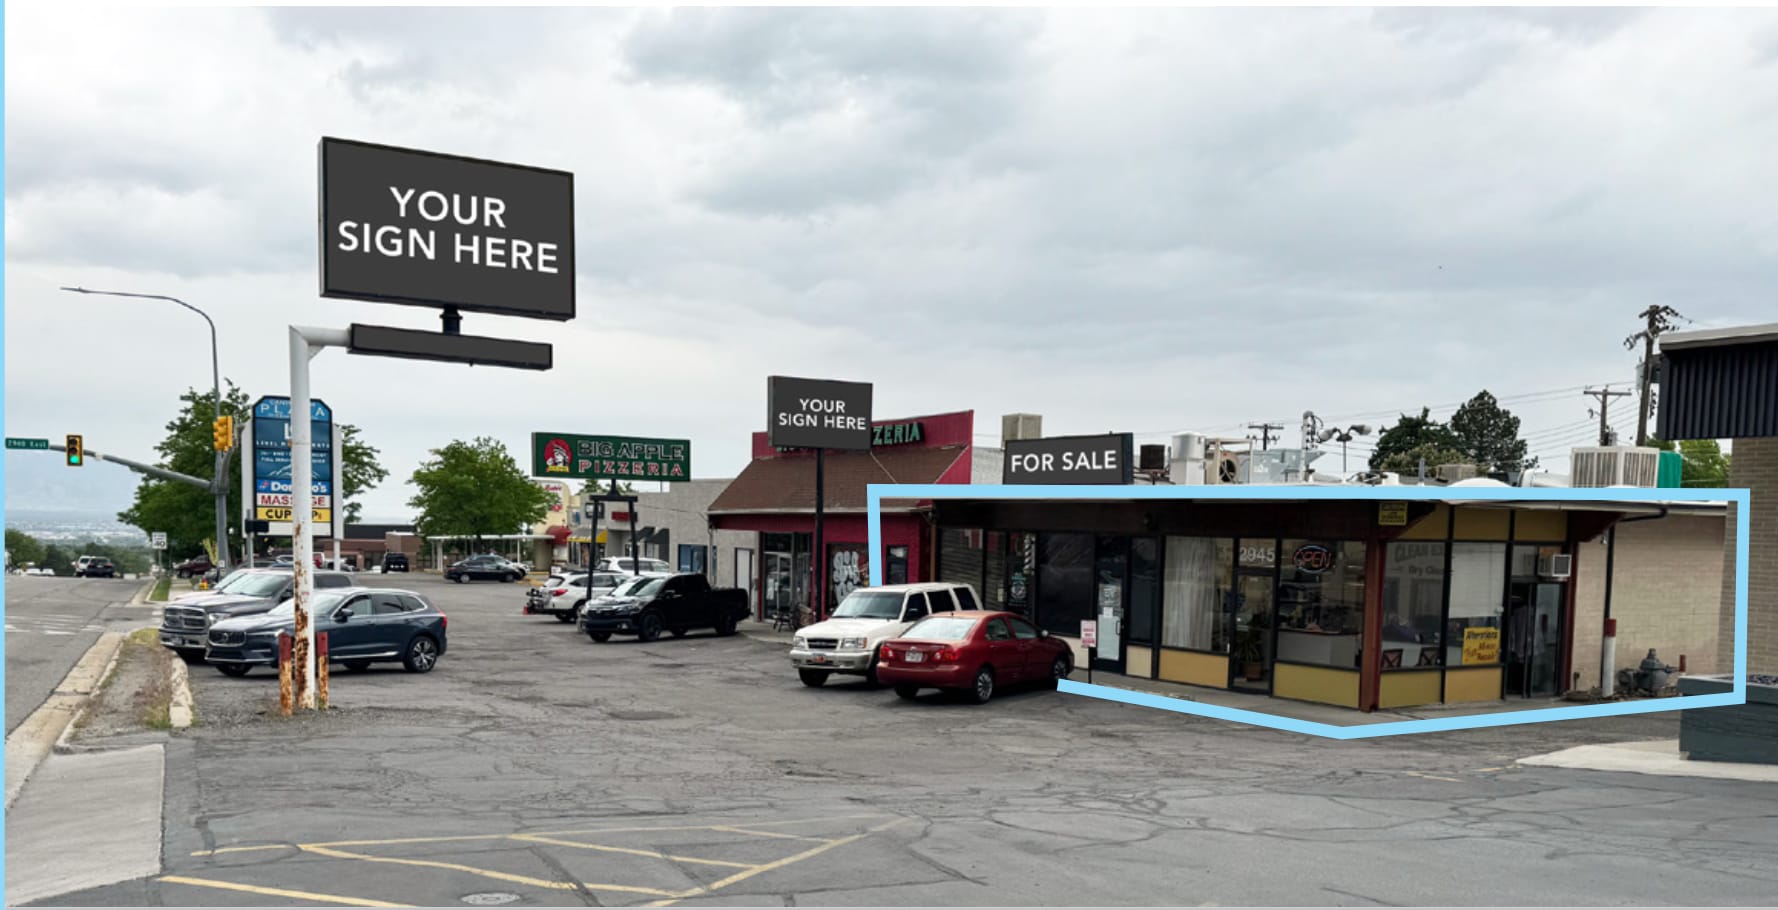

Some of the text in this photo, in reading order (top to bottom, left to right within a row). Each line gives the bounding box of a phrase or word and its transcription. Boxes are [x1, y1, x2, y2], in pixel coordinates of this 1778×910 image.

[390, 186, 506, 228] YOUR
[338, 220, 559, 274] SIGN HERE
[800, 398, 846, 413] YOUR
[778, 412, 866, 430] SIGN HERE
[577, 440, 684, 461] BIG APPLE
[578, 459, 684, 477] PIZZERIA
[1011, 450, 1117, 472] FOR SALE
[1239, 547, 1276, 562] 2945
[1293, 551, 1332, 568] OPEN
[1394, 544, 1429, 562] CLEAN
